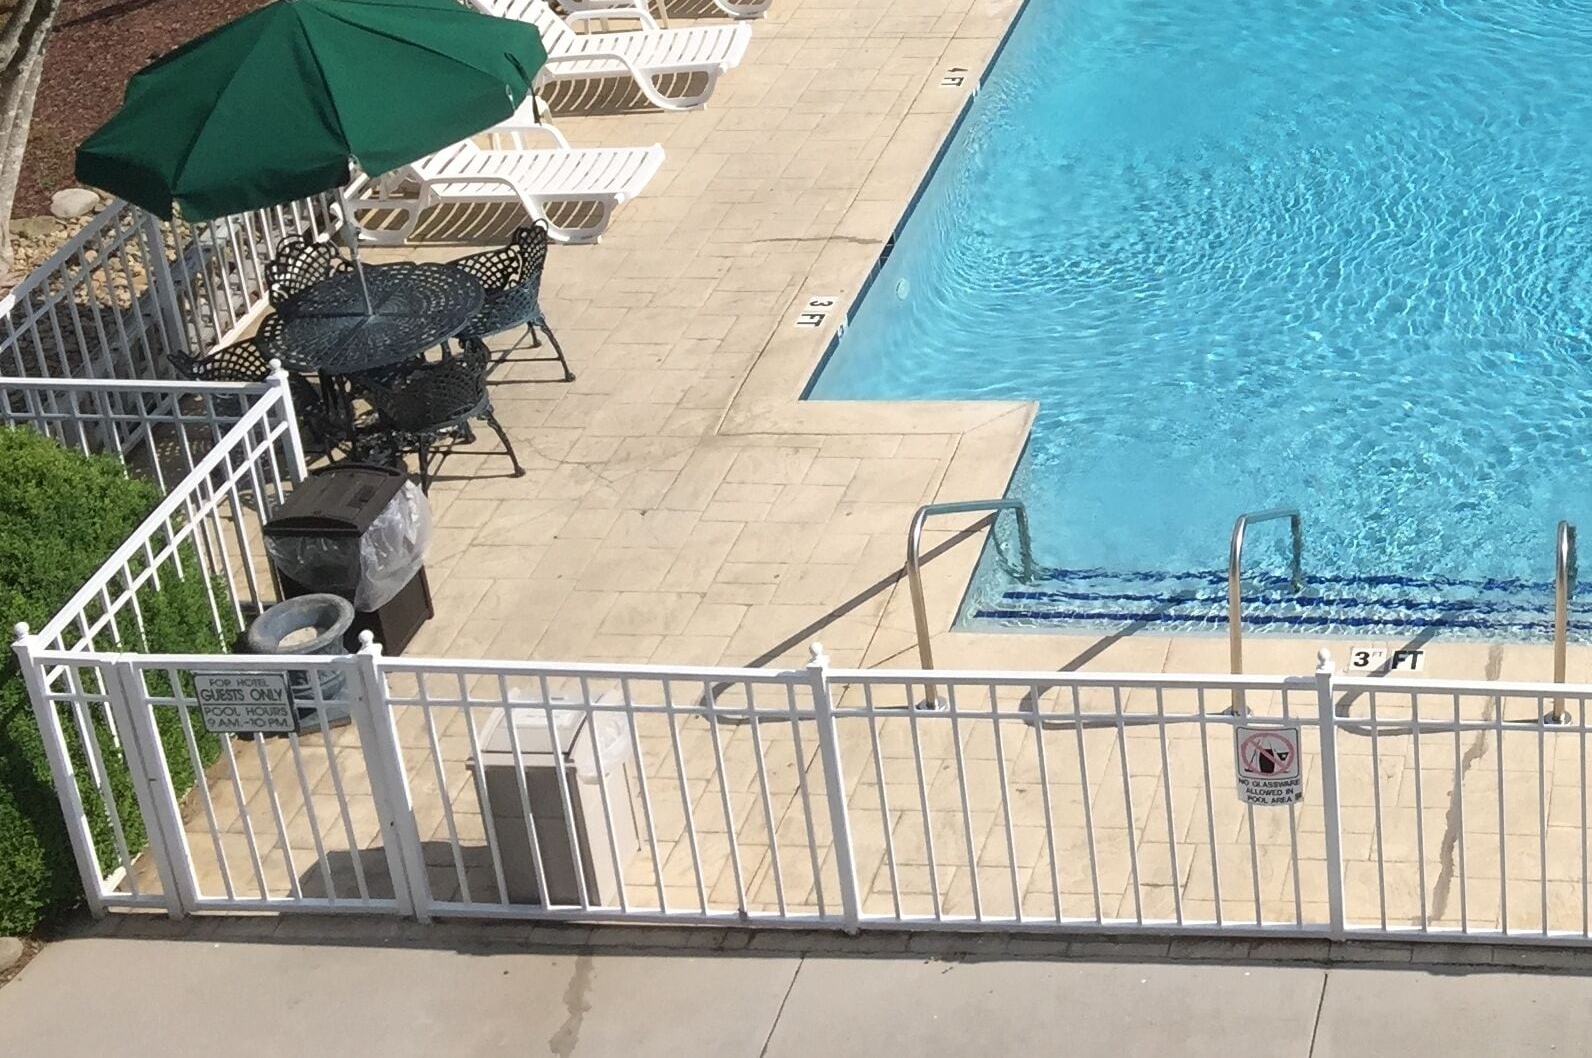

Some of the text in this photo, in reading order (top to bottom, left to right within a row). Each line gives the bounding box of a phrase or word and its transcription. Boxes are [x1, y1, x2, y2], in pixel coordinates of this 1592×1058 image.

[941, 77, 965, 87] FT
[797, 313, 826, 327] FT
[1353, 651, 1370, 667] 3
[1391, 650, 1424, 670] FT
[236, 678, 270, 687] HOTEL
[200, 688, 283, 701] GUESTS ONLY
[204, 706, 288, 717] POOL HOURS
[1238, 778, 1300, 788] NO GLASSWARE
[1246, 787, 1283, 796] ALLOWED
[1247, 795, 1293, 804] POOL AREA
